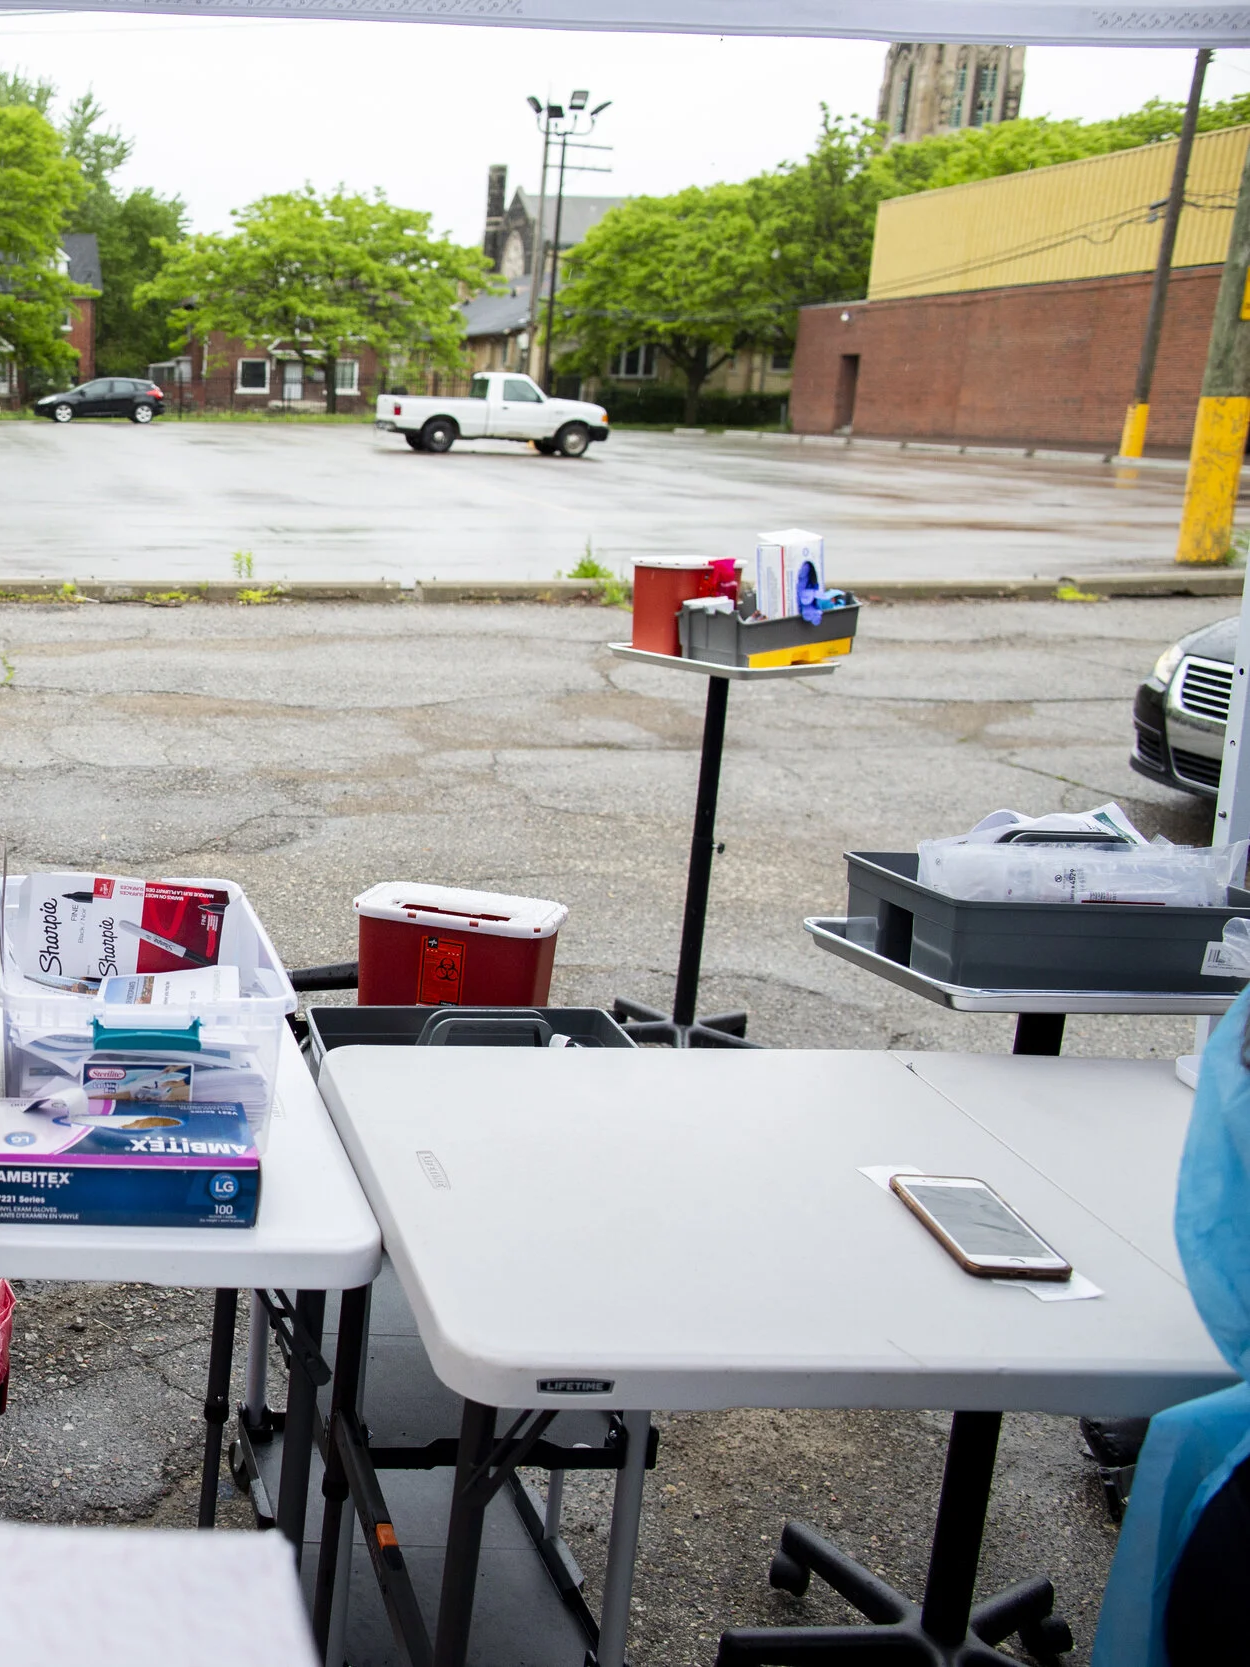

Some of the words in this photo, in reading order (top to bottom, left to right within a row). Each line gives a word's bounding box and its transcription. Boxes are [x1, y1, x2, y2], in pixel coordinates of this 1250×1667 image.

[71, 904, 79, 922] FINE
[39, 897, 62, 976] Sharpie
[98, 916, 118, 976] Sharpie
[92, 1070, 121, 1078] Sterilite
[13, 1136, 31, 1145] LG
[131, 1137, 247, 1157] AMBITEX
[215, 1181, 235, 1193] LG
[18, 1195, 45, 1204] Series
[214, 1204, 233, 1215] 100
[546, 1382, 604, 1391] LIFETIME
